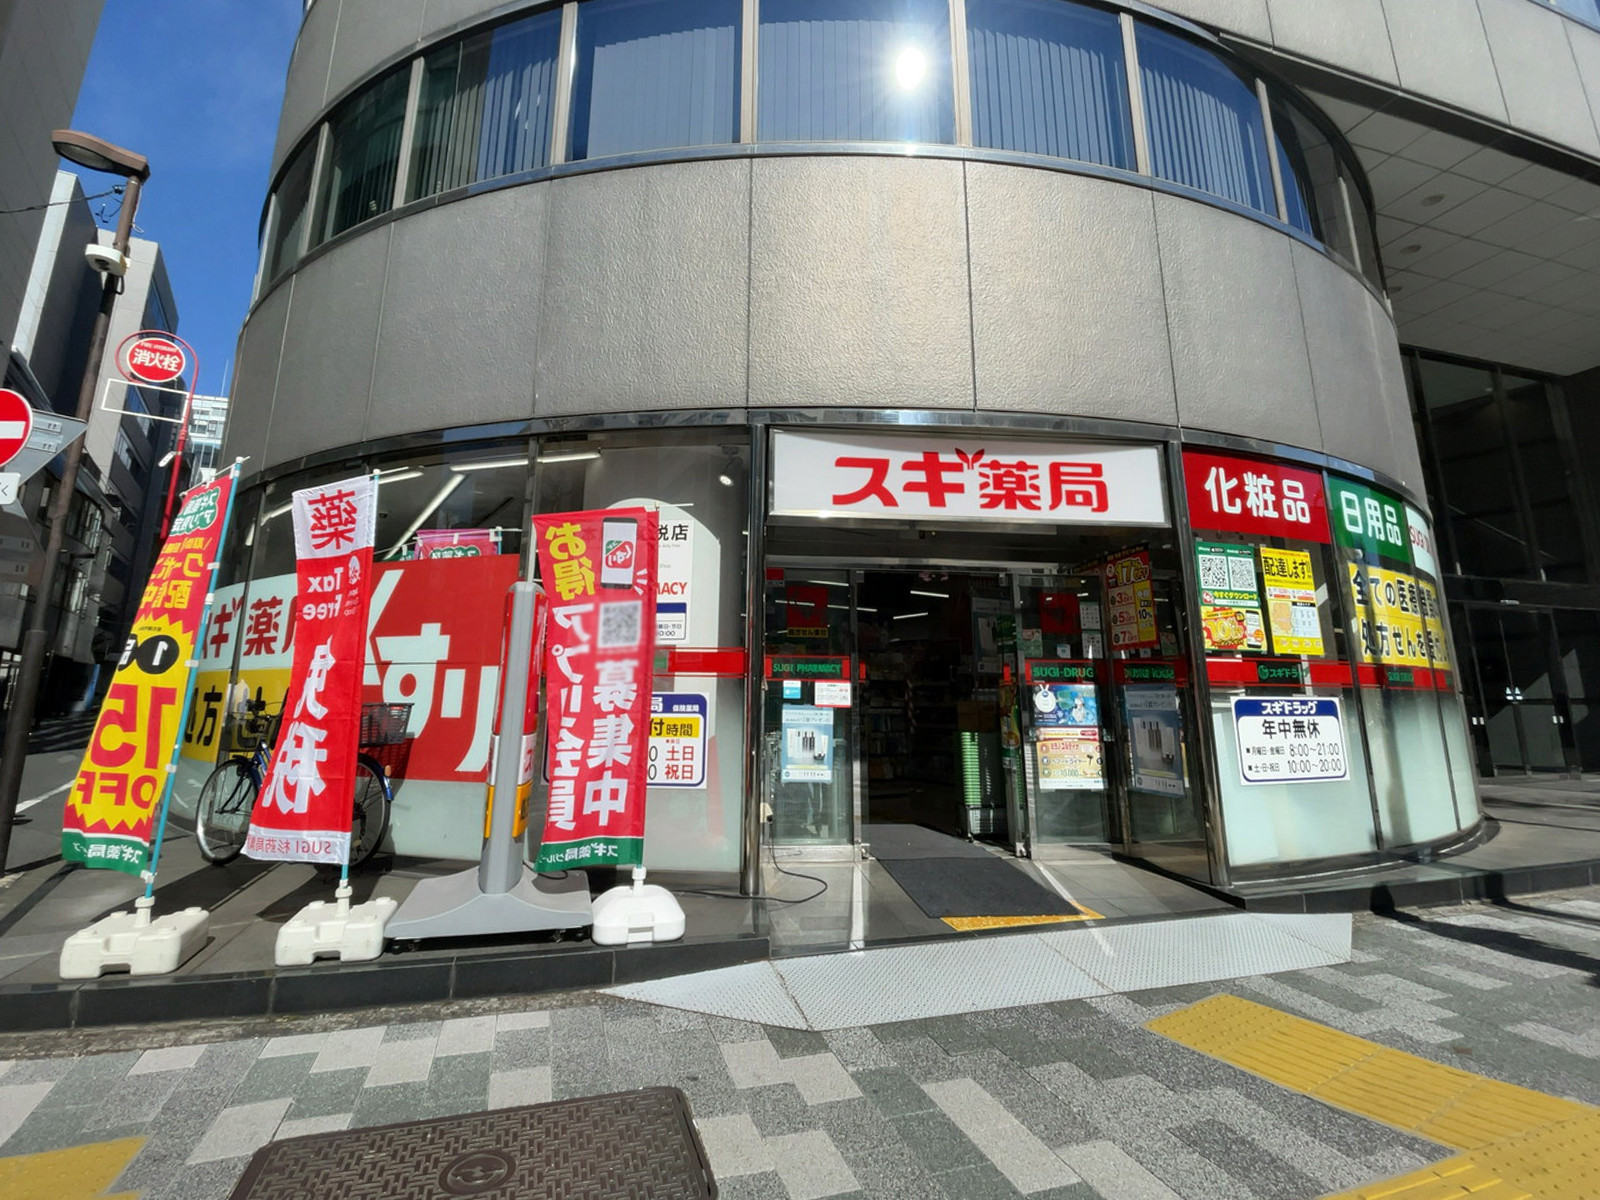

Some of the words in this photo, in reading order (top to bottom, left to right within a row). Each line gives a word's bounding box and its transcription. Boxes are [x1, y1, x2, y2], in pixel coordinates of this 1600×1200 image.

[132, 347, 180, 373] 消火栓
[832, 448, 1109, 513] スギ薬局
[1203, 465, 1312, 525] 化粧品
[1340, 490, 1403, 547] 日用品
[1260, 700, 1318, 715] スギドラッグ
[1261, 718, 1321, 740] 年中無休
[665, 745, 695, 762] 土日
[664, 763, 694, 781] 祝日
